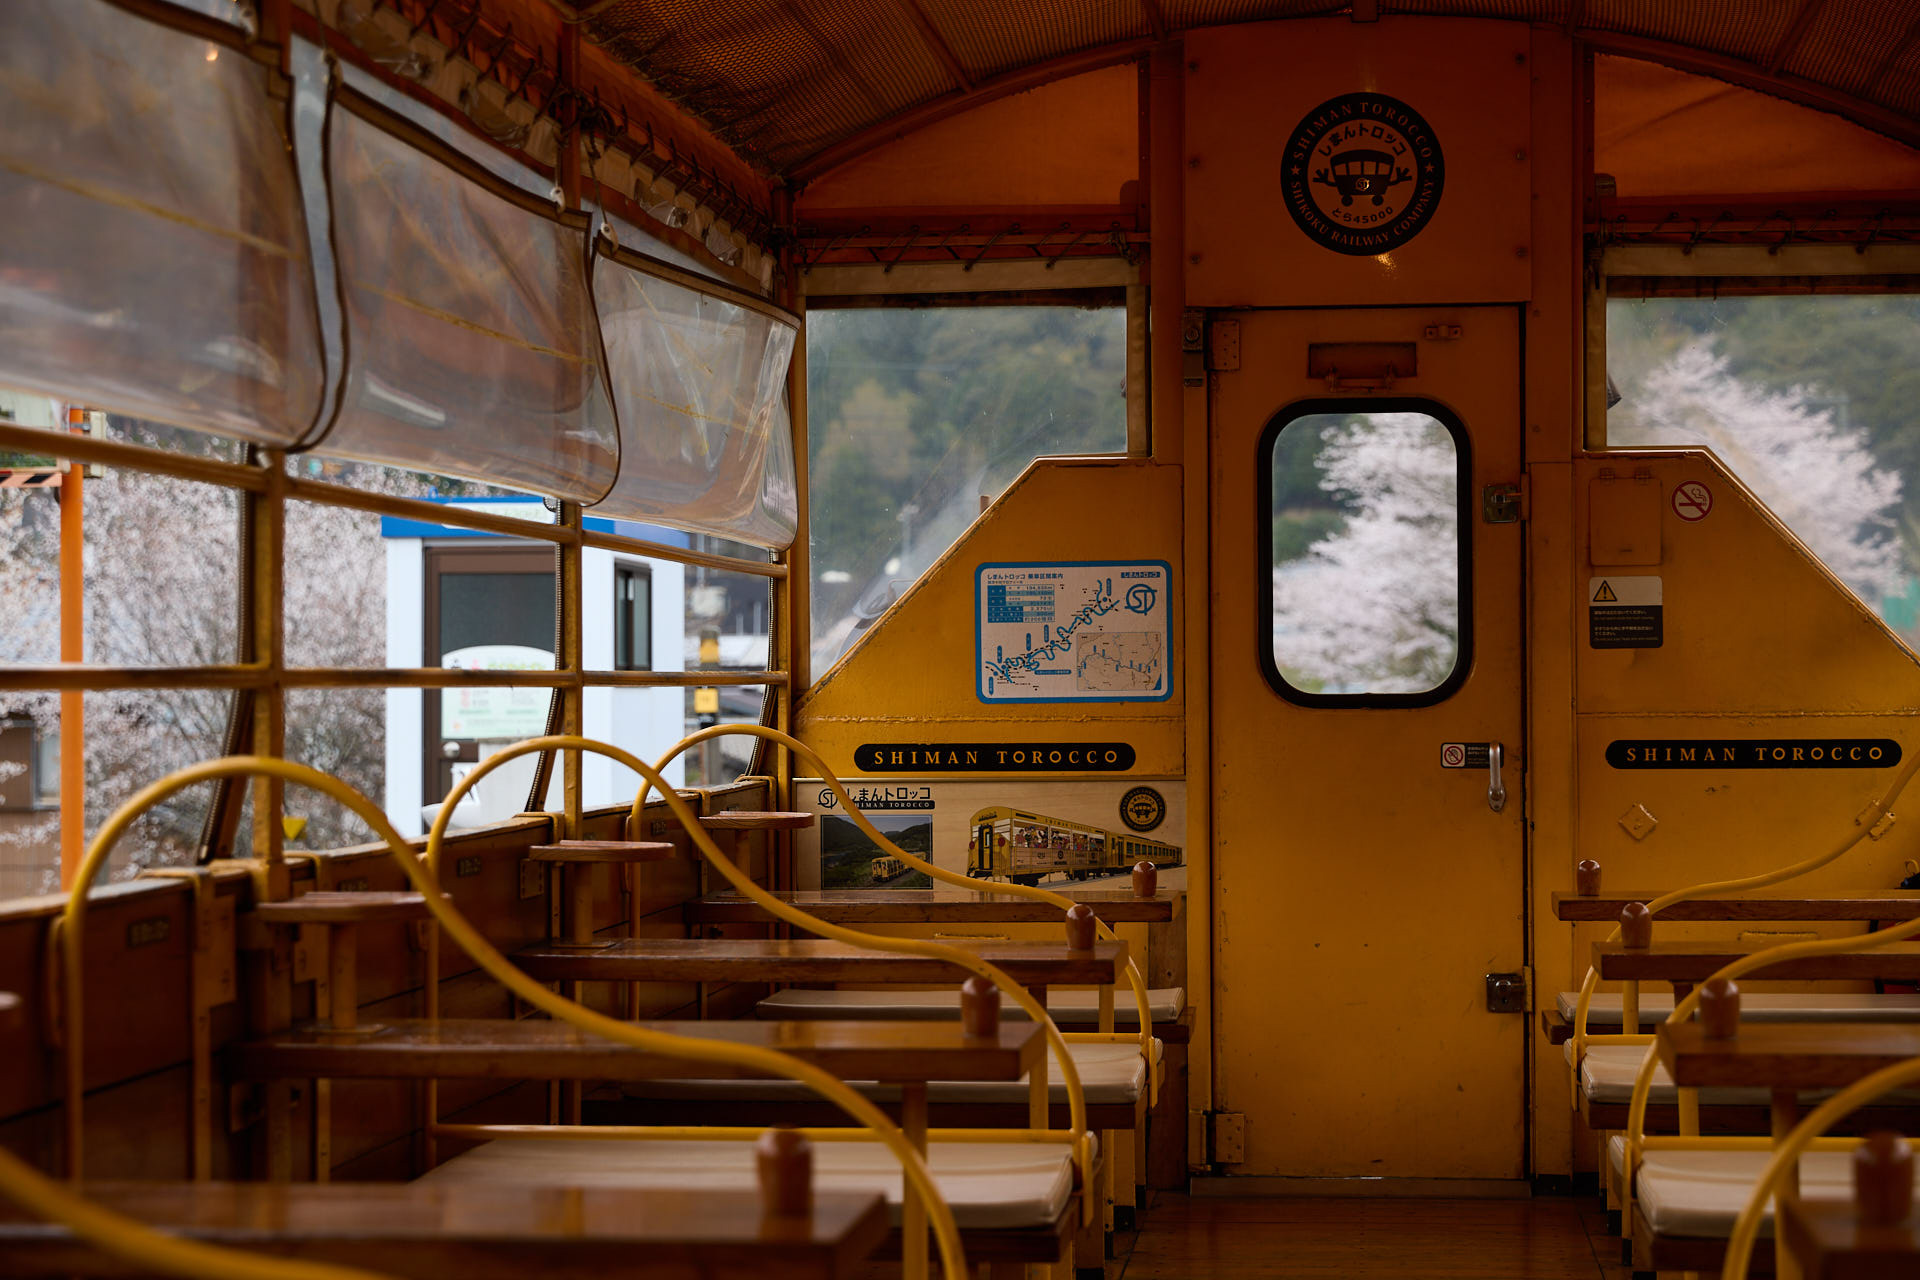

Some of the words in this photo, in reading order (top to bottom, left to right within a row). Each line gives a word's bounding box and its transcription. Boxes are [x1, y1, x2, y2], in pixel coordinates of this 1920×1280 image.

[1292, 103, 1352, 161] SHIMAN
[1359, 101, 1433, 159] TOROCCO
[1318, 122, 1408, 157] しまんトロッコ
[1290, 180, 1330, 235] SHIKOKU
[1331, 229, 1390, 247] RAILWAY
[1393, 180, 1435, 237] COMPANY
[874, 750, 978, 765] SHIMAN
[997, 750, 1118, 765] TOROCCO
[1626, 747, 1736, 762] SHIMAN
[1755, 746, 1883, 761] TOROCCO
